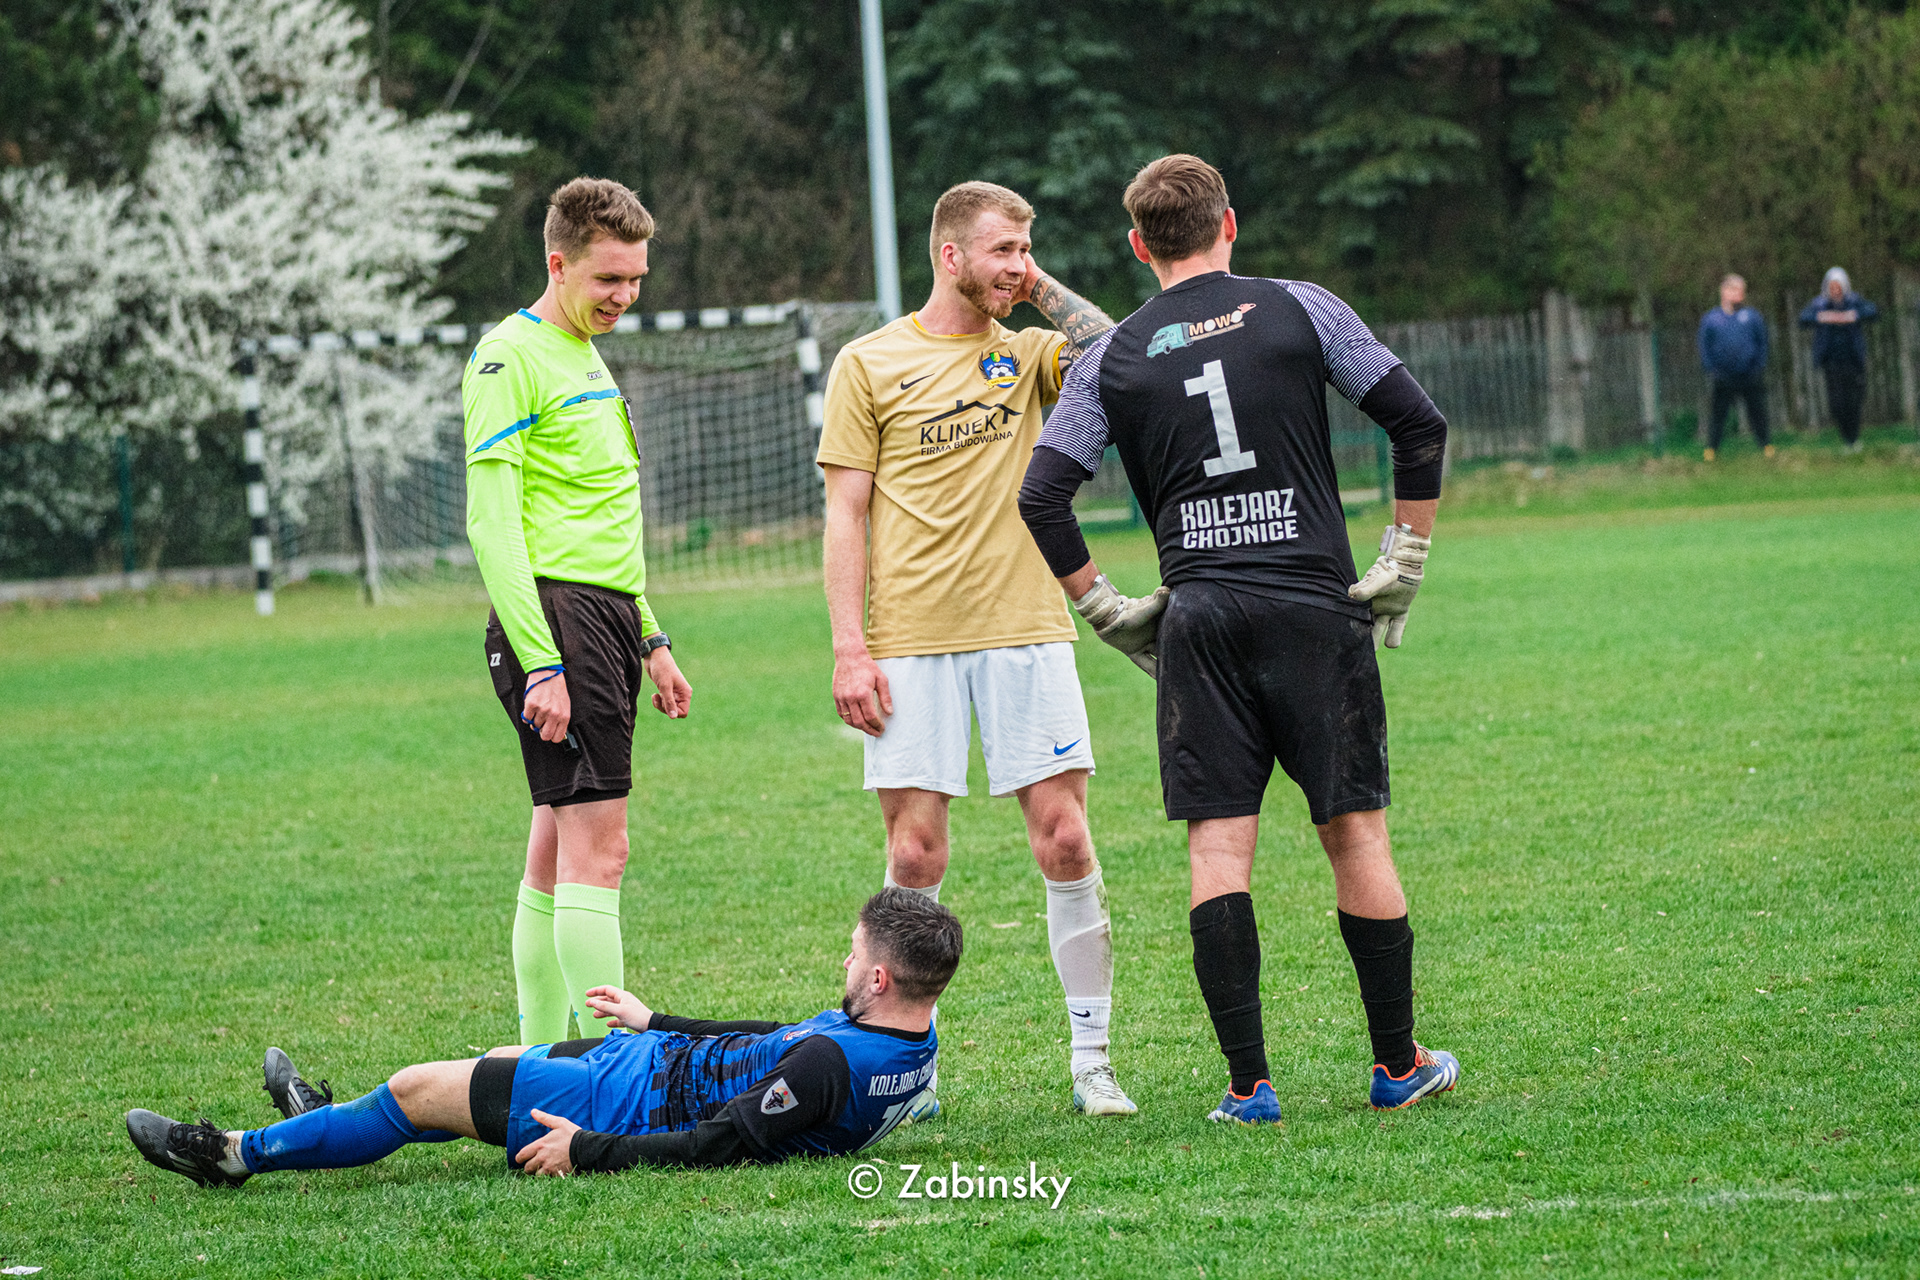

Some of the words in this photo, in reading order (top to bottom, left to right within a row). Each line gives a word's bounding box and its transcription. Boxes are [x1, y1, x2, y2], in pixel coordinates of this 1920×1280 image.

[920, 412, 998, 445] KLINEK
[1183, 359, 1257, 477] 1
[920, 443, 952, 456] FIRMA
[953, 431, 1014, 449] BUDOWLANA
[1180, 487, 1298, 532] KOLEJARZ
[1182, 519, 1299, 550] CHOJNICE
[867, 1068, 921, 1097] KOLEJARZ
